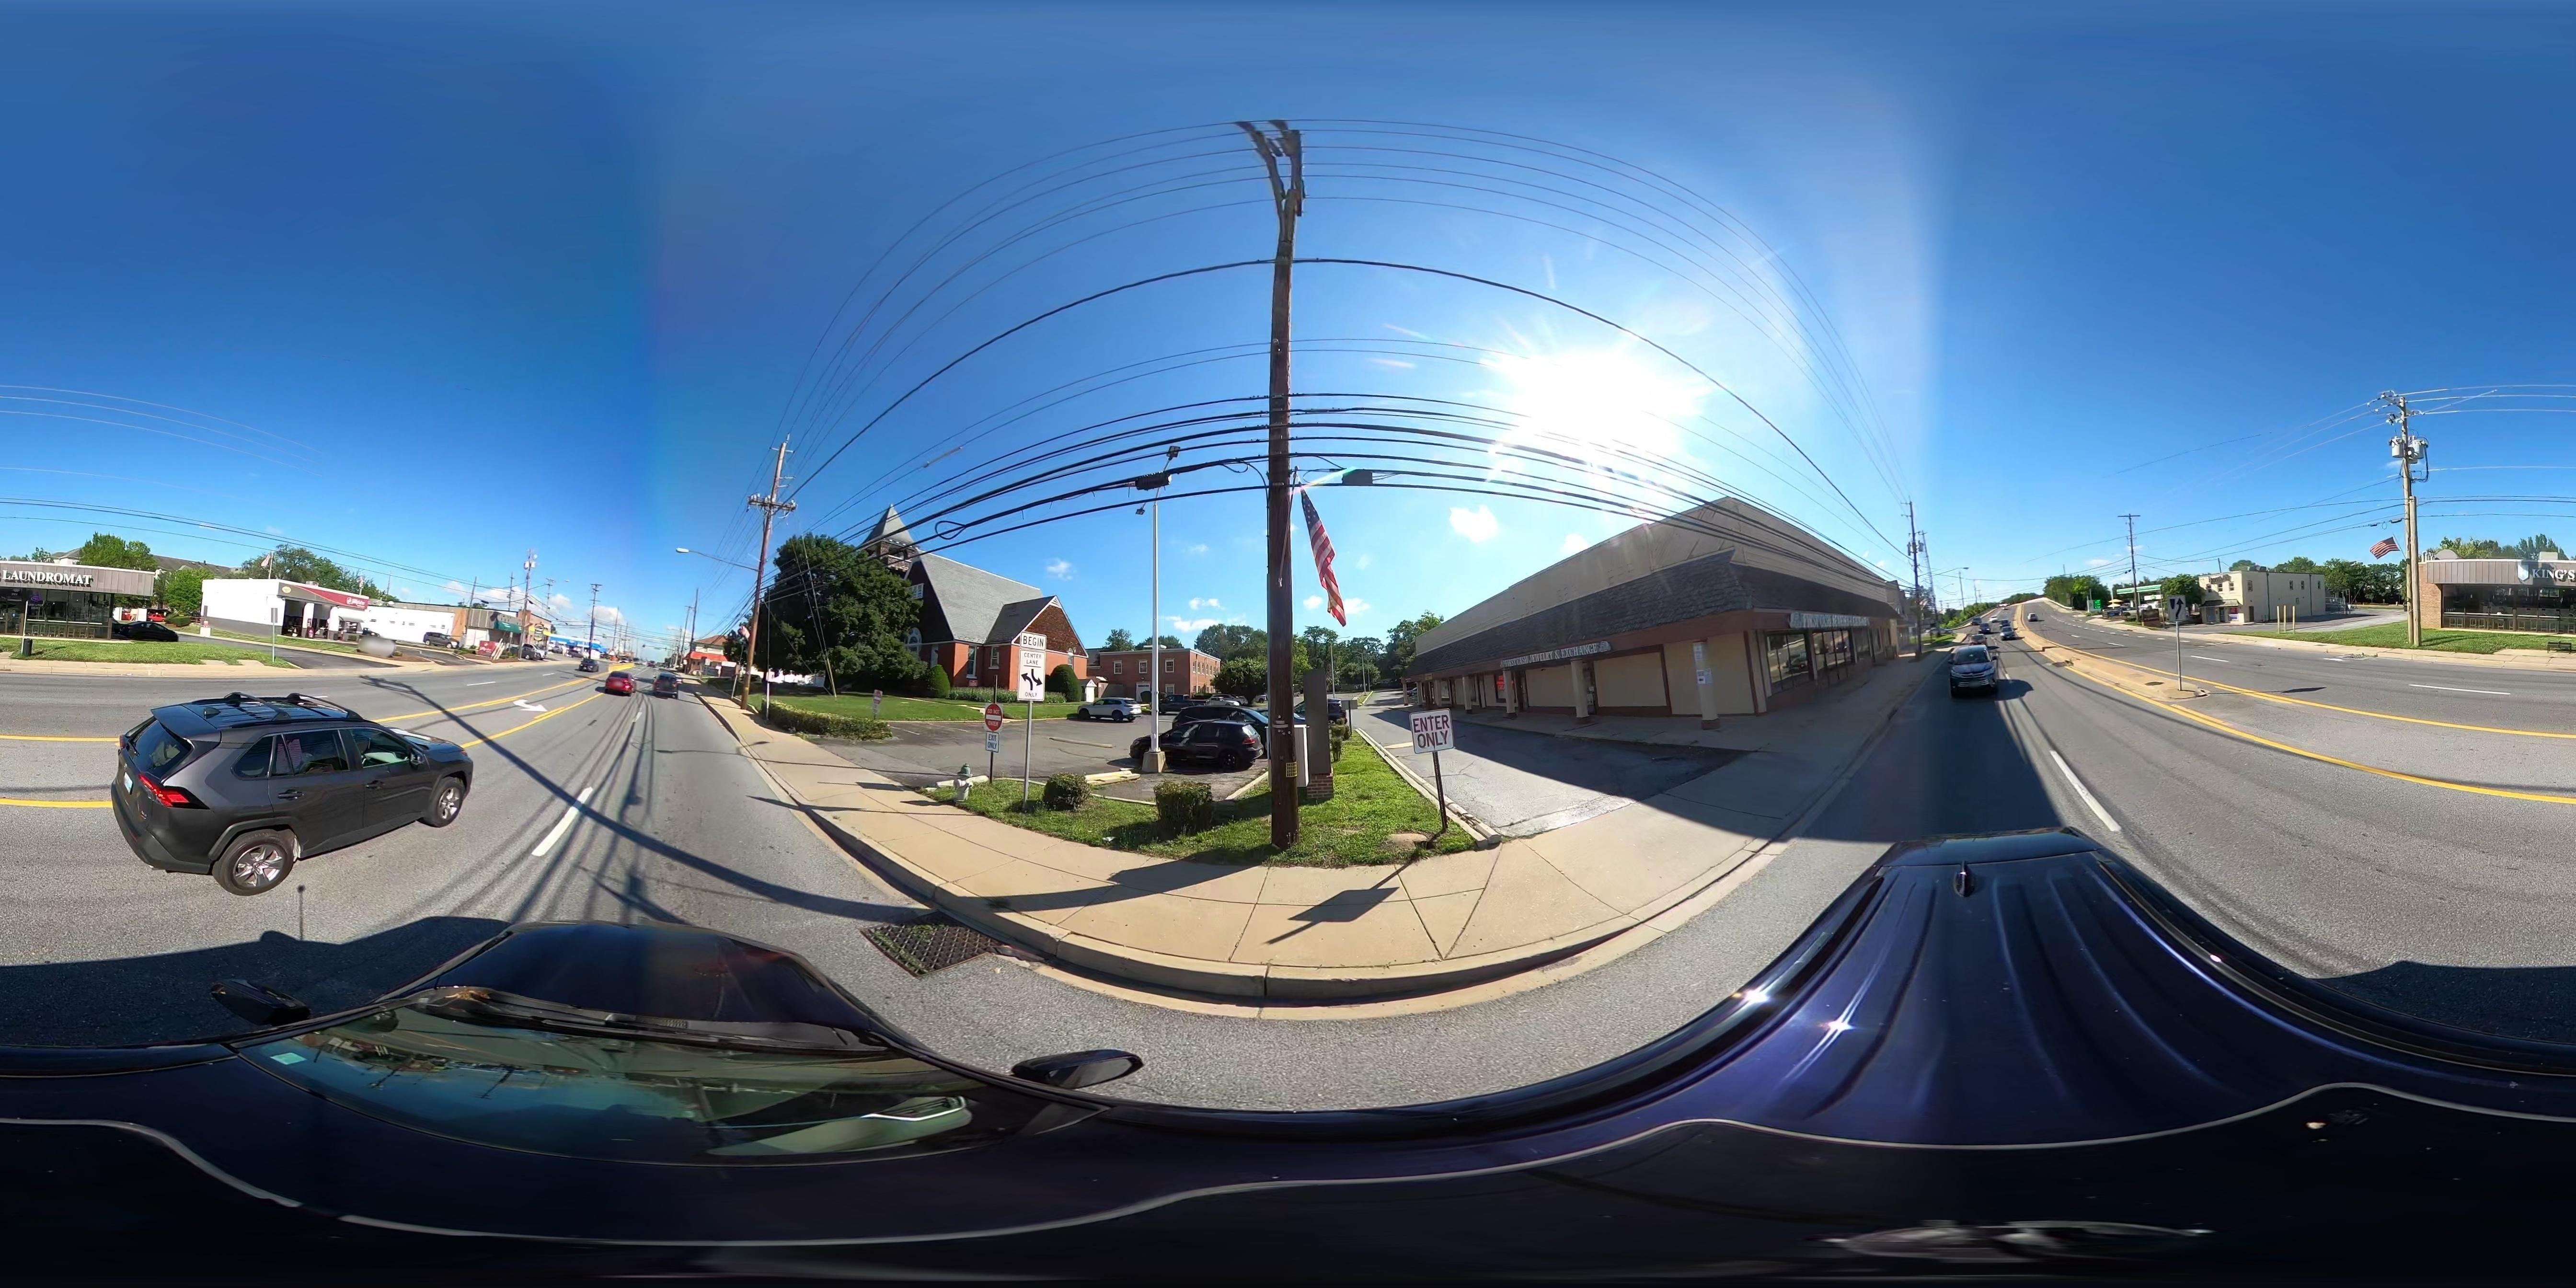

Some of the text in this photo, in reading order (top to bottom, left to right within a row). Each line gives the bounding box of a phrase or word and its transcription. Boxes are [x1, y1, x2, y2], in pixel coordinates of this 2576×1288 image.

[2, 569, 92, 585] LAUNDROMAT
[2532, 569, 2575, 579] KING'S
[1023, 636, 1044, 647] BEGIN
[1530, 651, 1552, 663] JEWELRY
[1554, 649, 1560, 659] &
[1561, 643, 1599, 658] EXCHANGE
[1413, 714, 1449, 733] ENTER
[1417, 730, 1448, 748] ONLY
